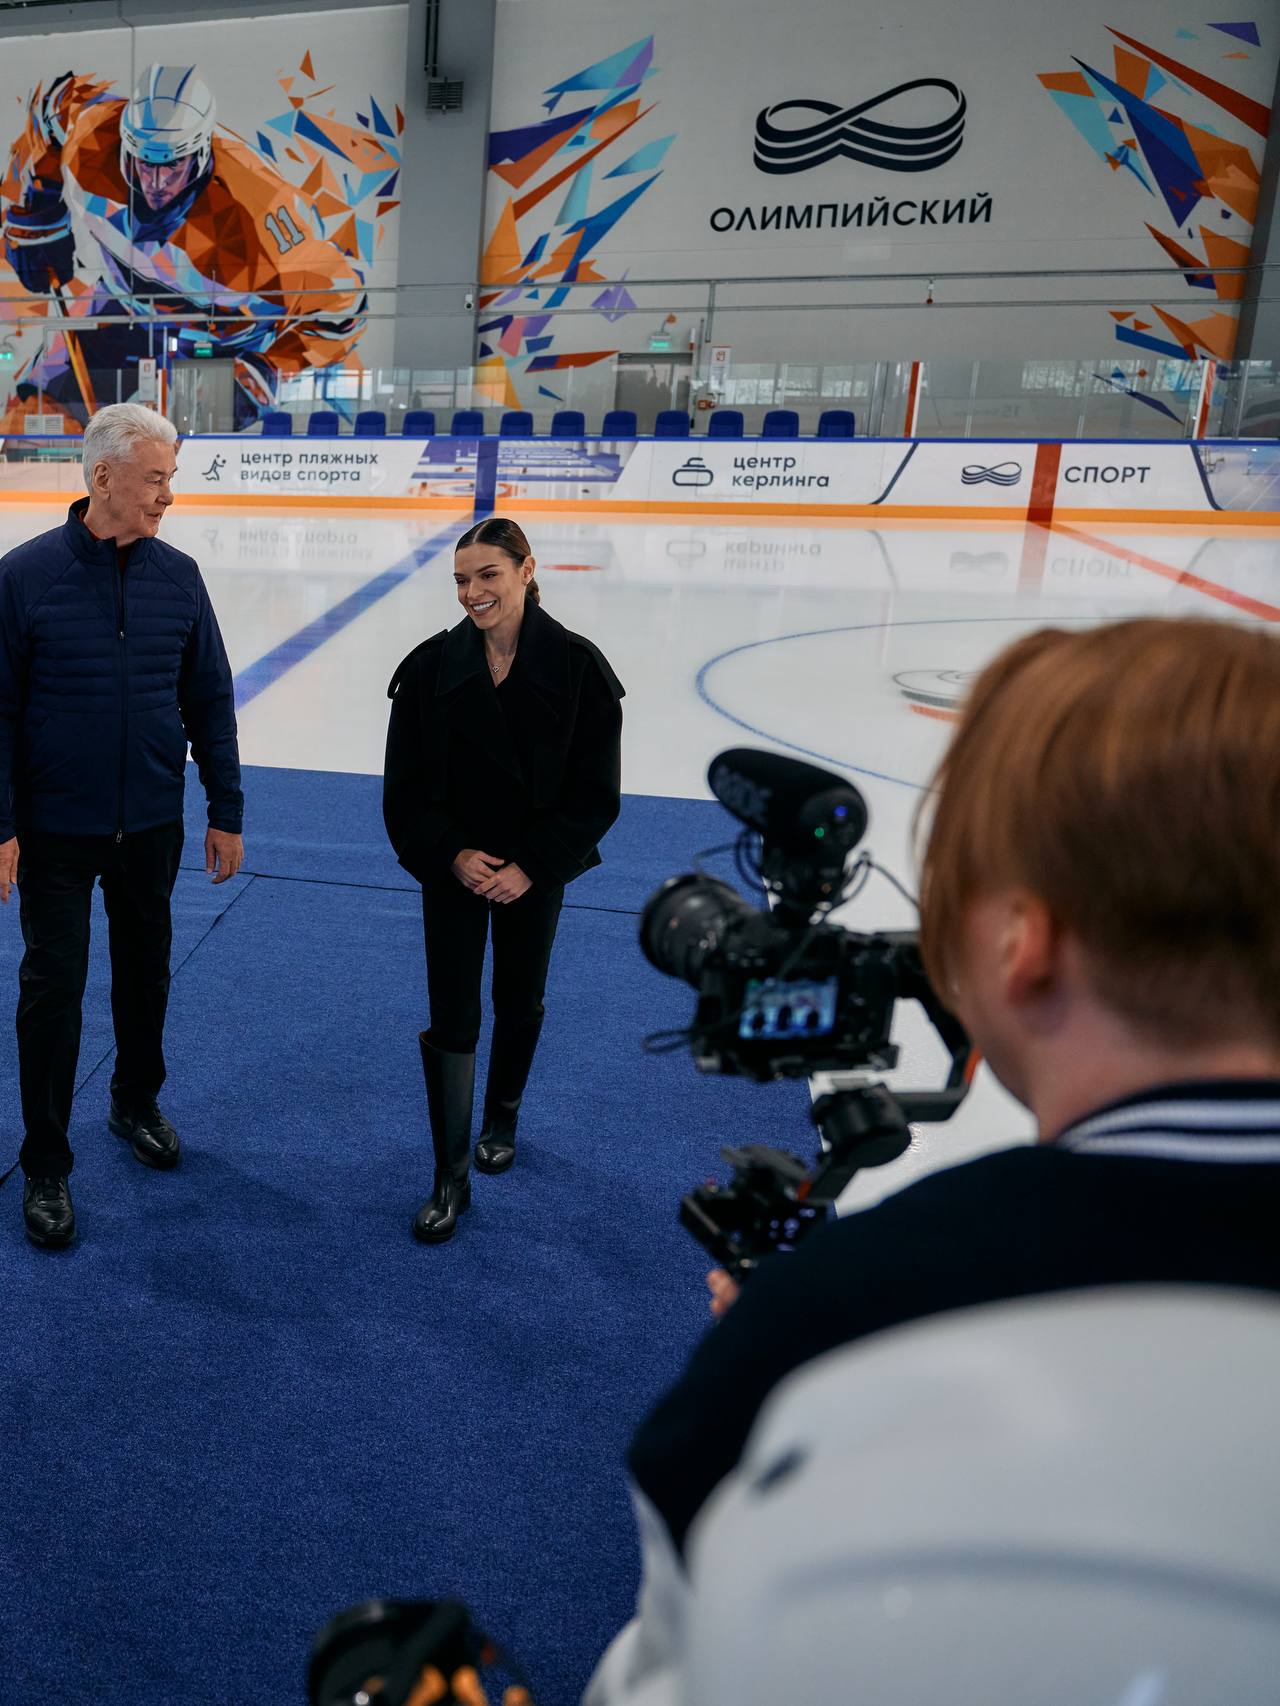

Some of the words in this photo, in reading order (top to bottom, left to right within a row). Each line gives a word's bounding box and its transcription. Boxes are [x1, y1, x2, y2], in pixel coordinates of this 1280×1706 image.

[709, 191, 993, 233] ОЛИМПИЙСКИЙ
[264, 205, 305, 255] 11
[241, 453, 293, 467] центр
[299, 453, 379, 464] пляжных
[733, 456, 796, 472] центр
[240, 470, 291, 482] видов
[297, 470, 361, 484] спорта
[732, 475, 830, 490] керлинга
[1064, 466, 1151, 484] СПОРТ
